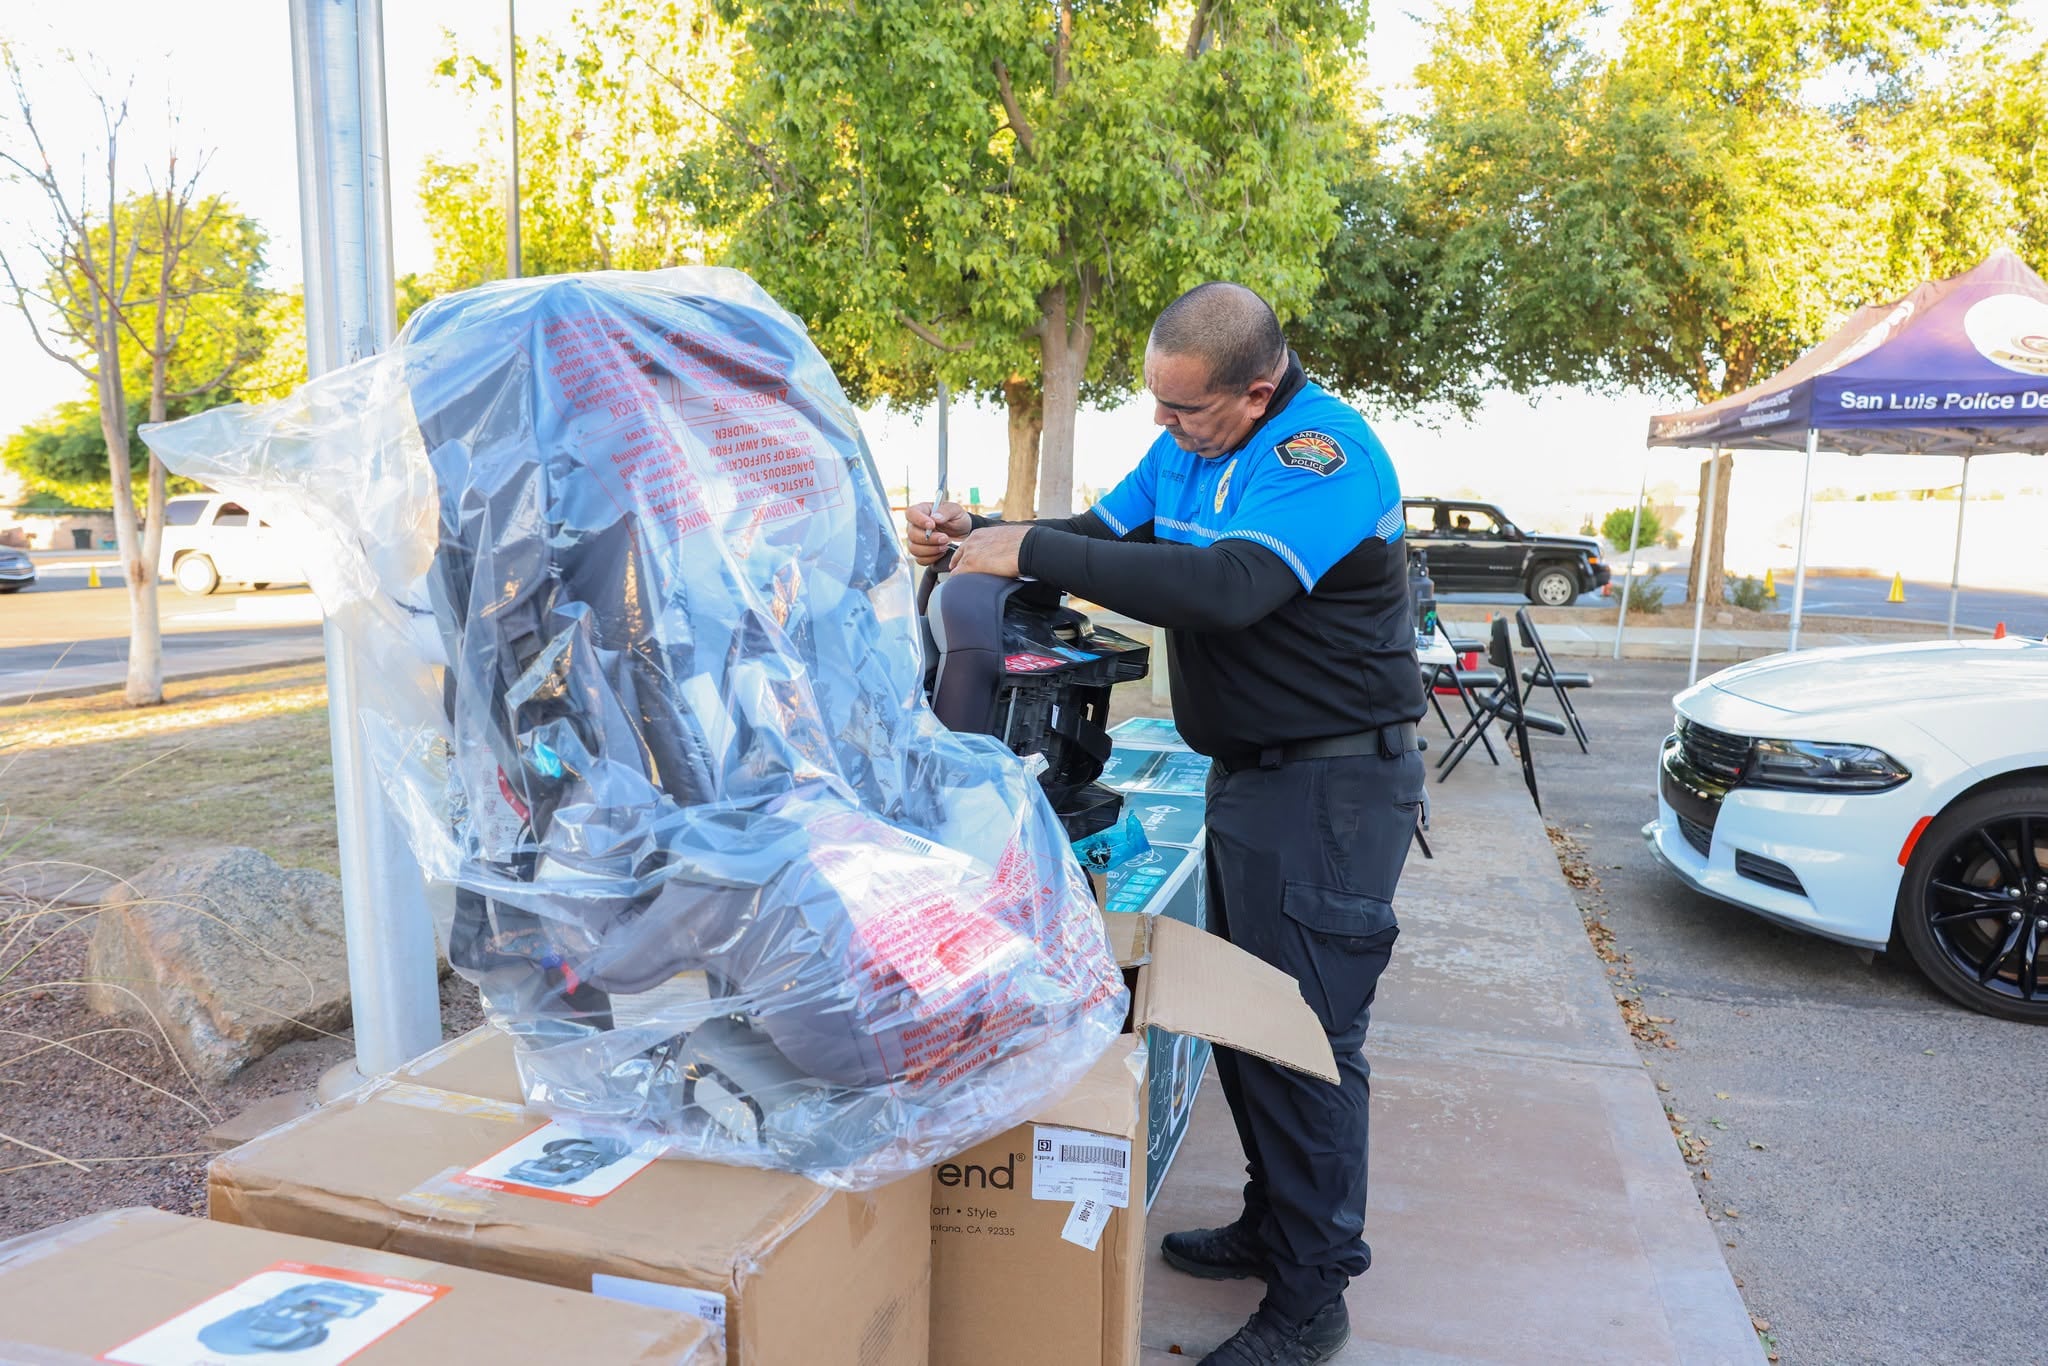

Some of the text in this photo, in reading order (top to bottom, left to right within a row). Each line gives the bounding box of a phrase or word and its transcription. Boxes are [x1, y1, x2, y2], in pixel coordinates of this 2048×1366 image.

[752, 392, 776, 407] MISE
[1840, 391, 2048, 409] San Luis Police De
[712, 423, 759, 440] CHILDREN.
[1292, 431, 1334, 445] SAN LUIS
[735, 440, 758, 453] AWAY
[761, 436, 777, 448] BAG
[708, 444, 732, 456] FROM
[715, 445, 815, 472] DANGER OF SUFFOCATION
[1290, 458, 1324, 472] POLICE
[619, 464, 636, 479] and
[750, 472, 760, 482] TO
[760, 483, 779, 496] BAGS
[781, 477, 813, 492] PLASTIC
[752, 501, 797, 521] WARNING
[677, 511, 711, 533] NING
[949, 1024, 960, 1034] to
[926, 1030, 948, 1047] nose
[904, 1042, 923, 1057] and
[903, 1056, 923, 1069] The
[938, 1052, 987, 1087] WARNING
[931, 1206, 997, 1219] ort Style
[931, 1225, 1015, 1236] ntana, CA 92335
